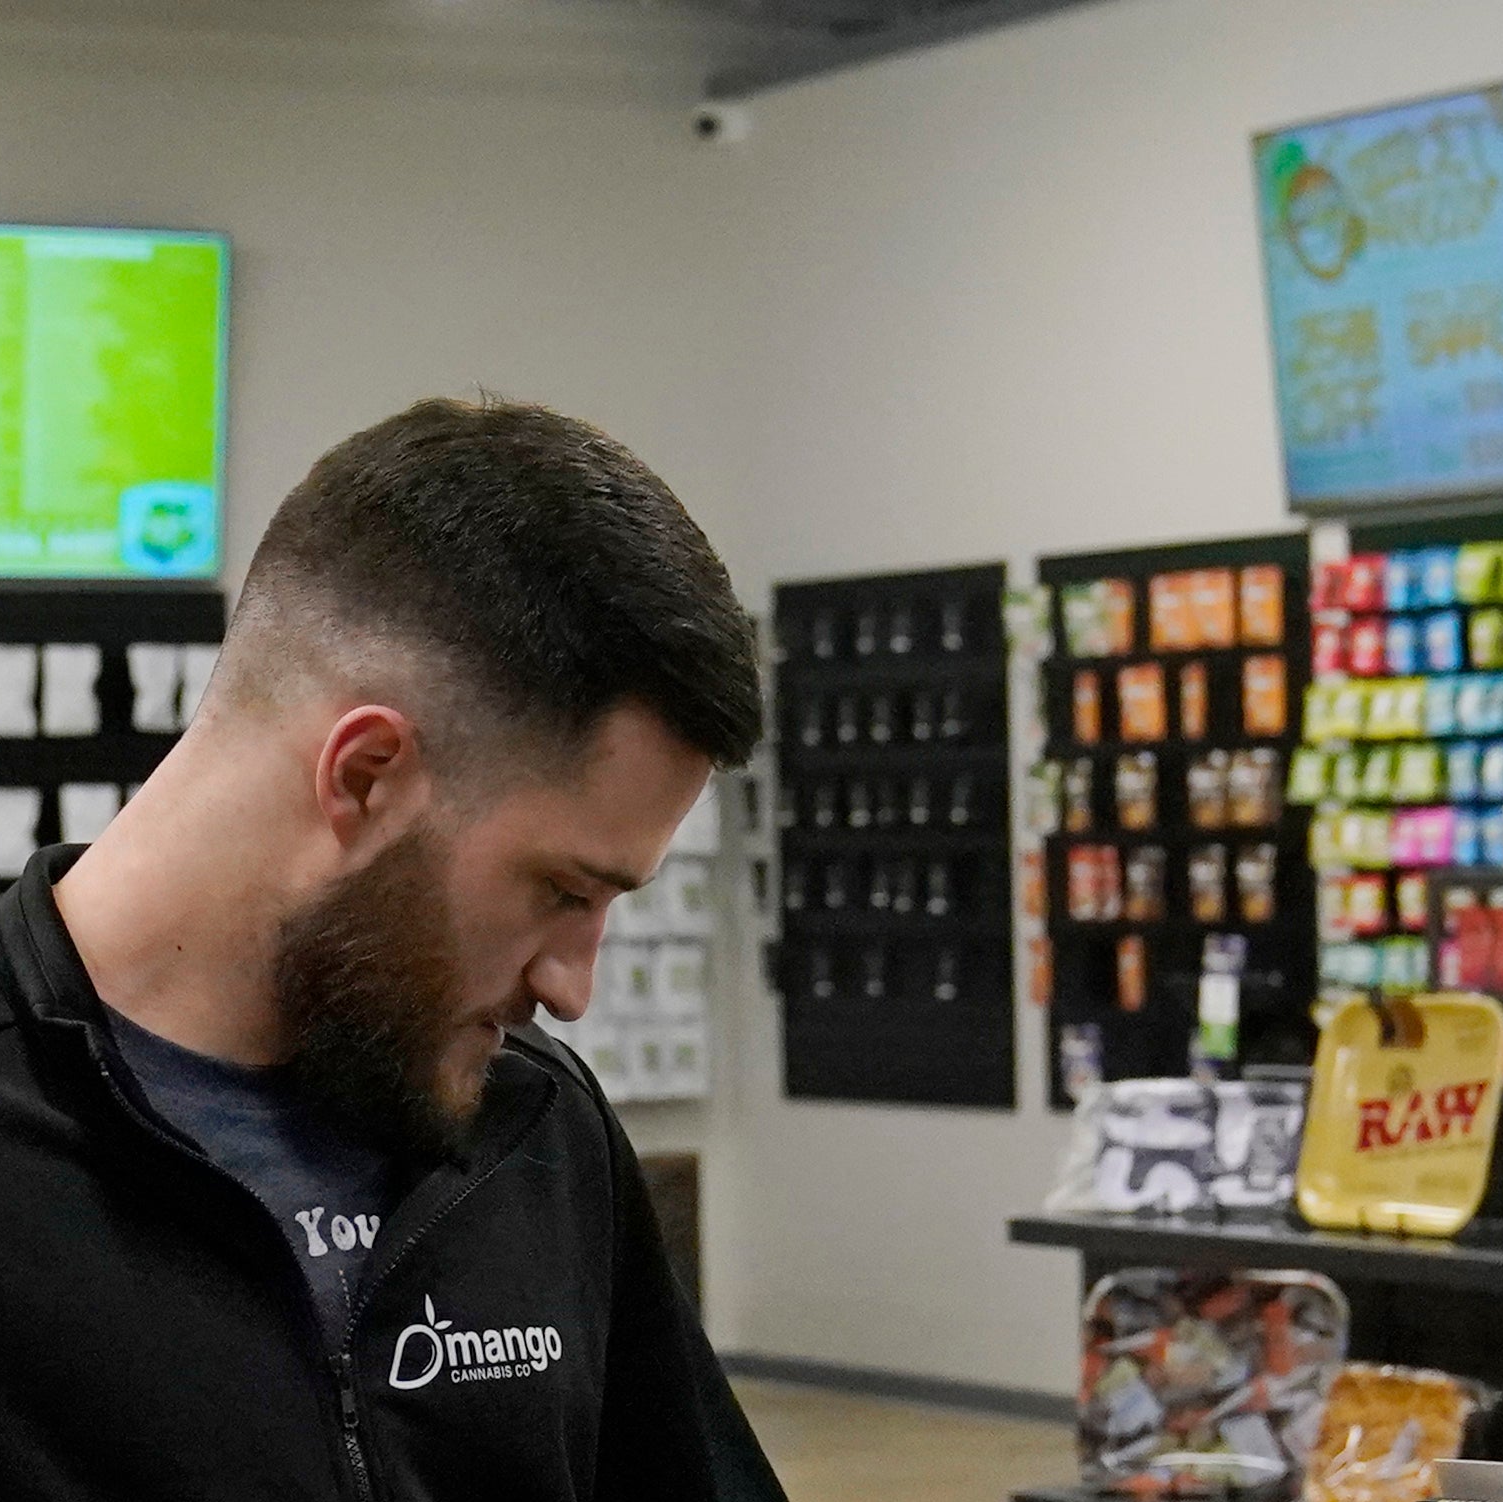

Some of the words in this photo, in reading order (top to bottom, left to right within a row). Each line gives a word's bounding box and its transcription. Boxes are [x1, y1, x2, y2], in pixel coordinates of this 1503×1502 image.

[1356, 1080, 1490, 1152] RAW
[444, 1325, 563, 1372] mango
[451, 1365, 513, 1384] CANNABIS
[515, 1362, 531, 1378] CO
